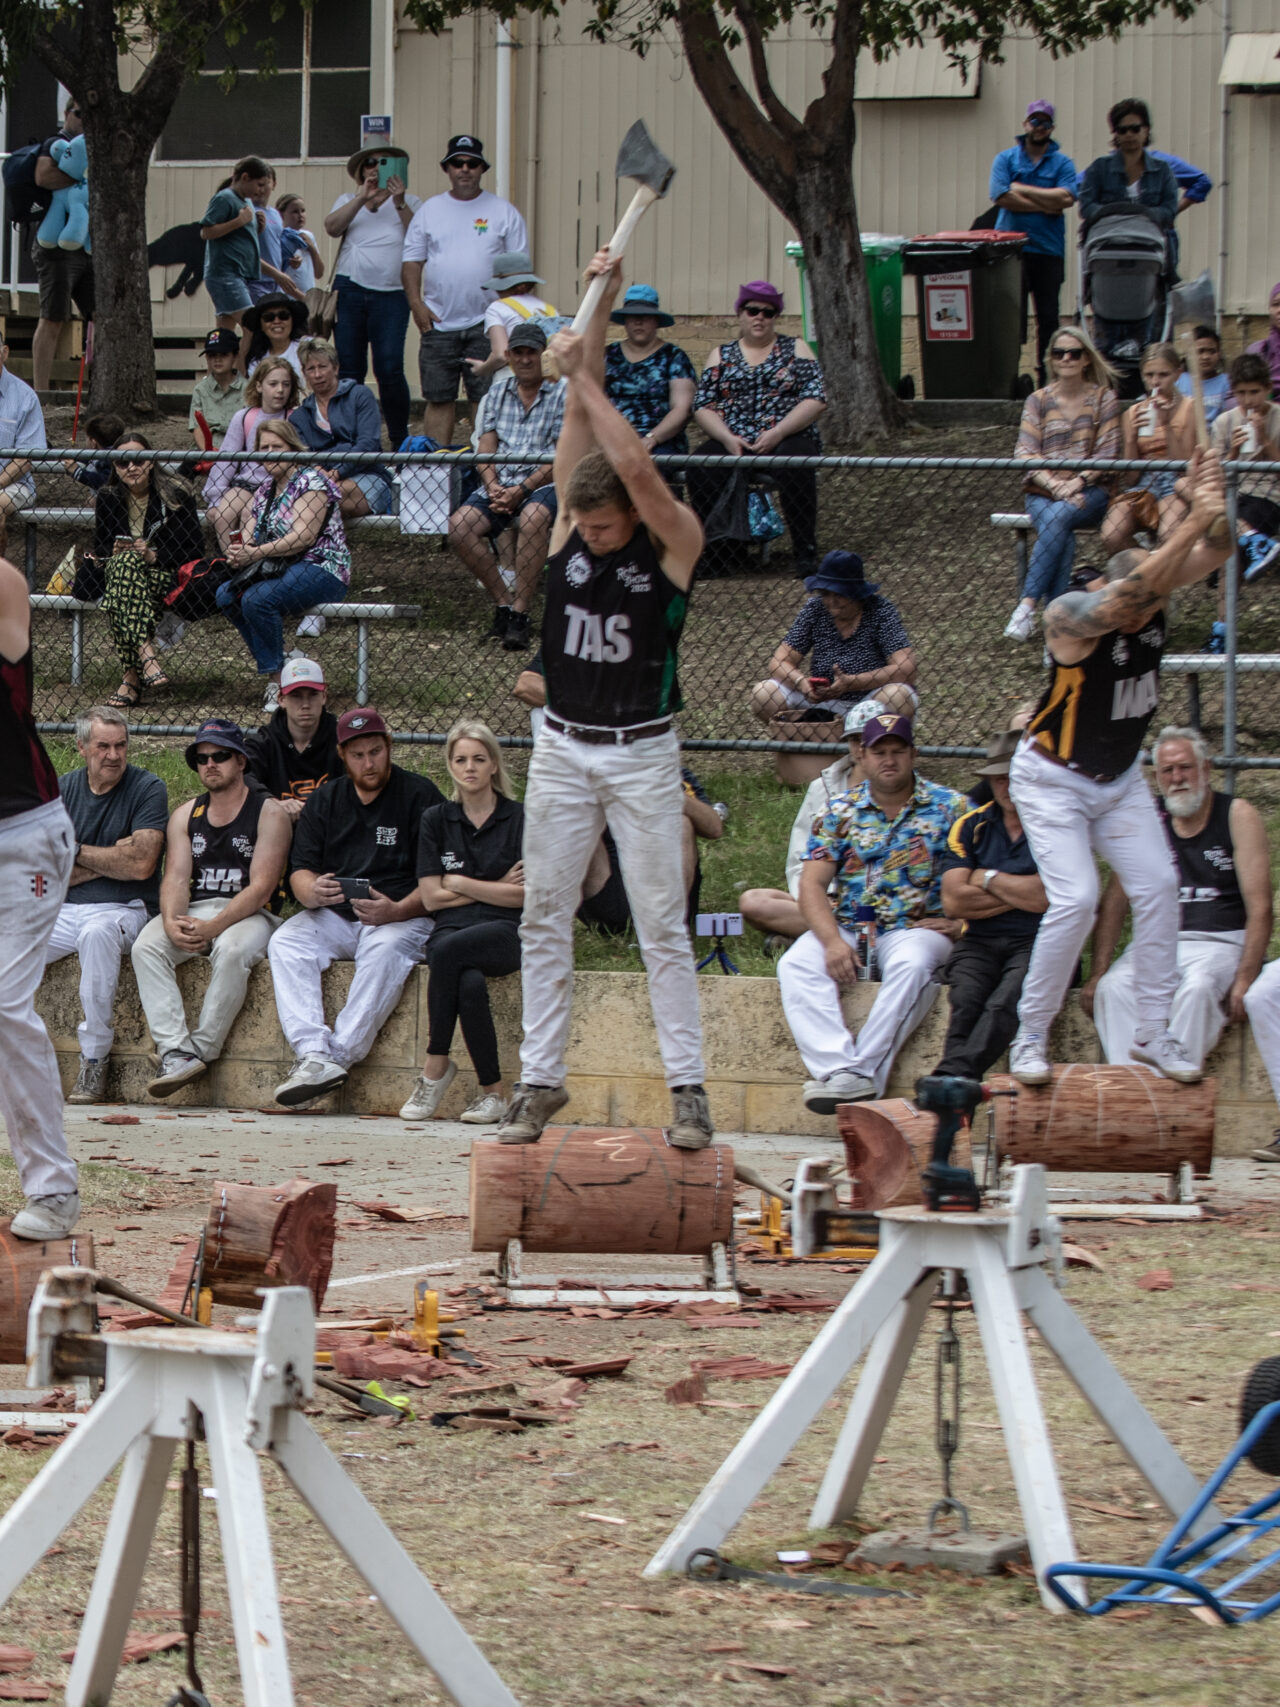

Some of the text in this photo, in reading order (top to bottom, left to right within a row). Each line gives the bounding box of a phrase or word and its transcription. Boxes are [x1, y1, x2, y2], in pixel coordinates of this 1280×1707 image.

[368, 118, 384, 126] WIN
[564, 603, 632, 663] TAS
[232, 837, 250, 847] ROYAL
